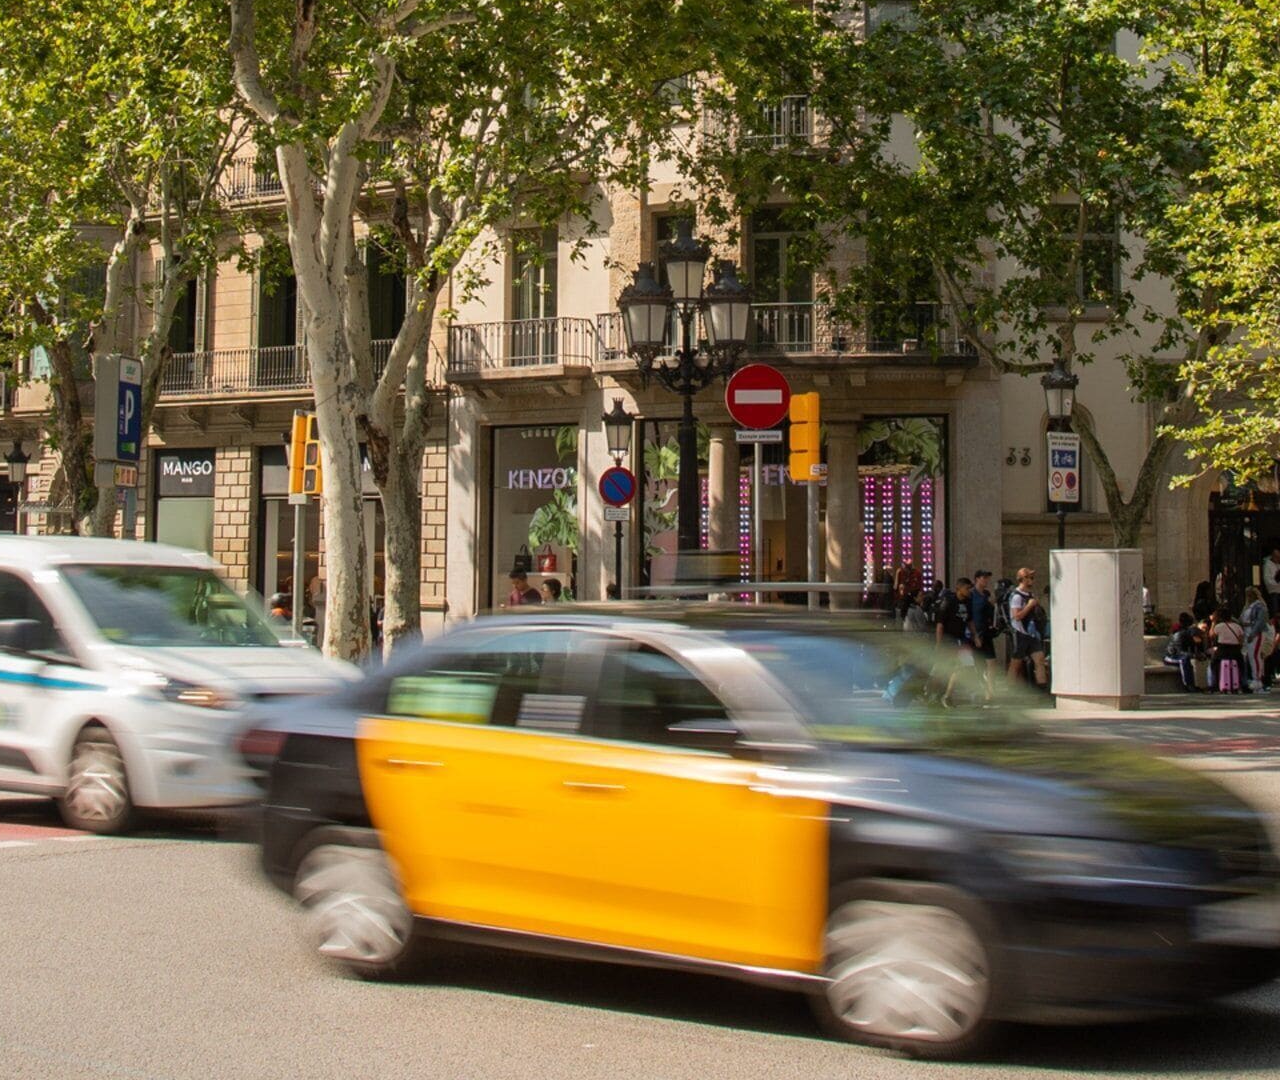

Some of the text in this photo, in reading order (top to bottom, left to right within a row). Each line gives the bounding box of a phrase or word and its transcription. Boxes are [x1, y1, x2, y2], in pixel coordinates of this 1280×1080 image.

[125, 390, 135, 435] P
[163, 460, 213, 476] MANGO
[508, 467, 567, 489] KENZO
